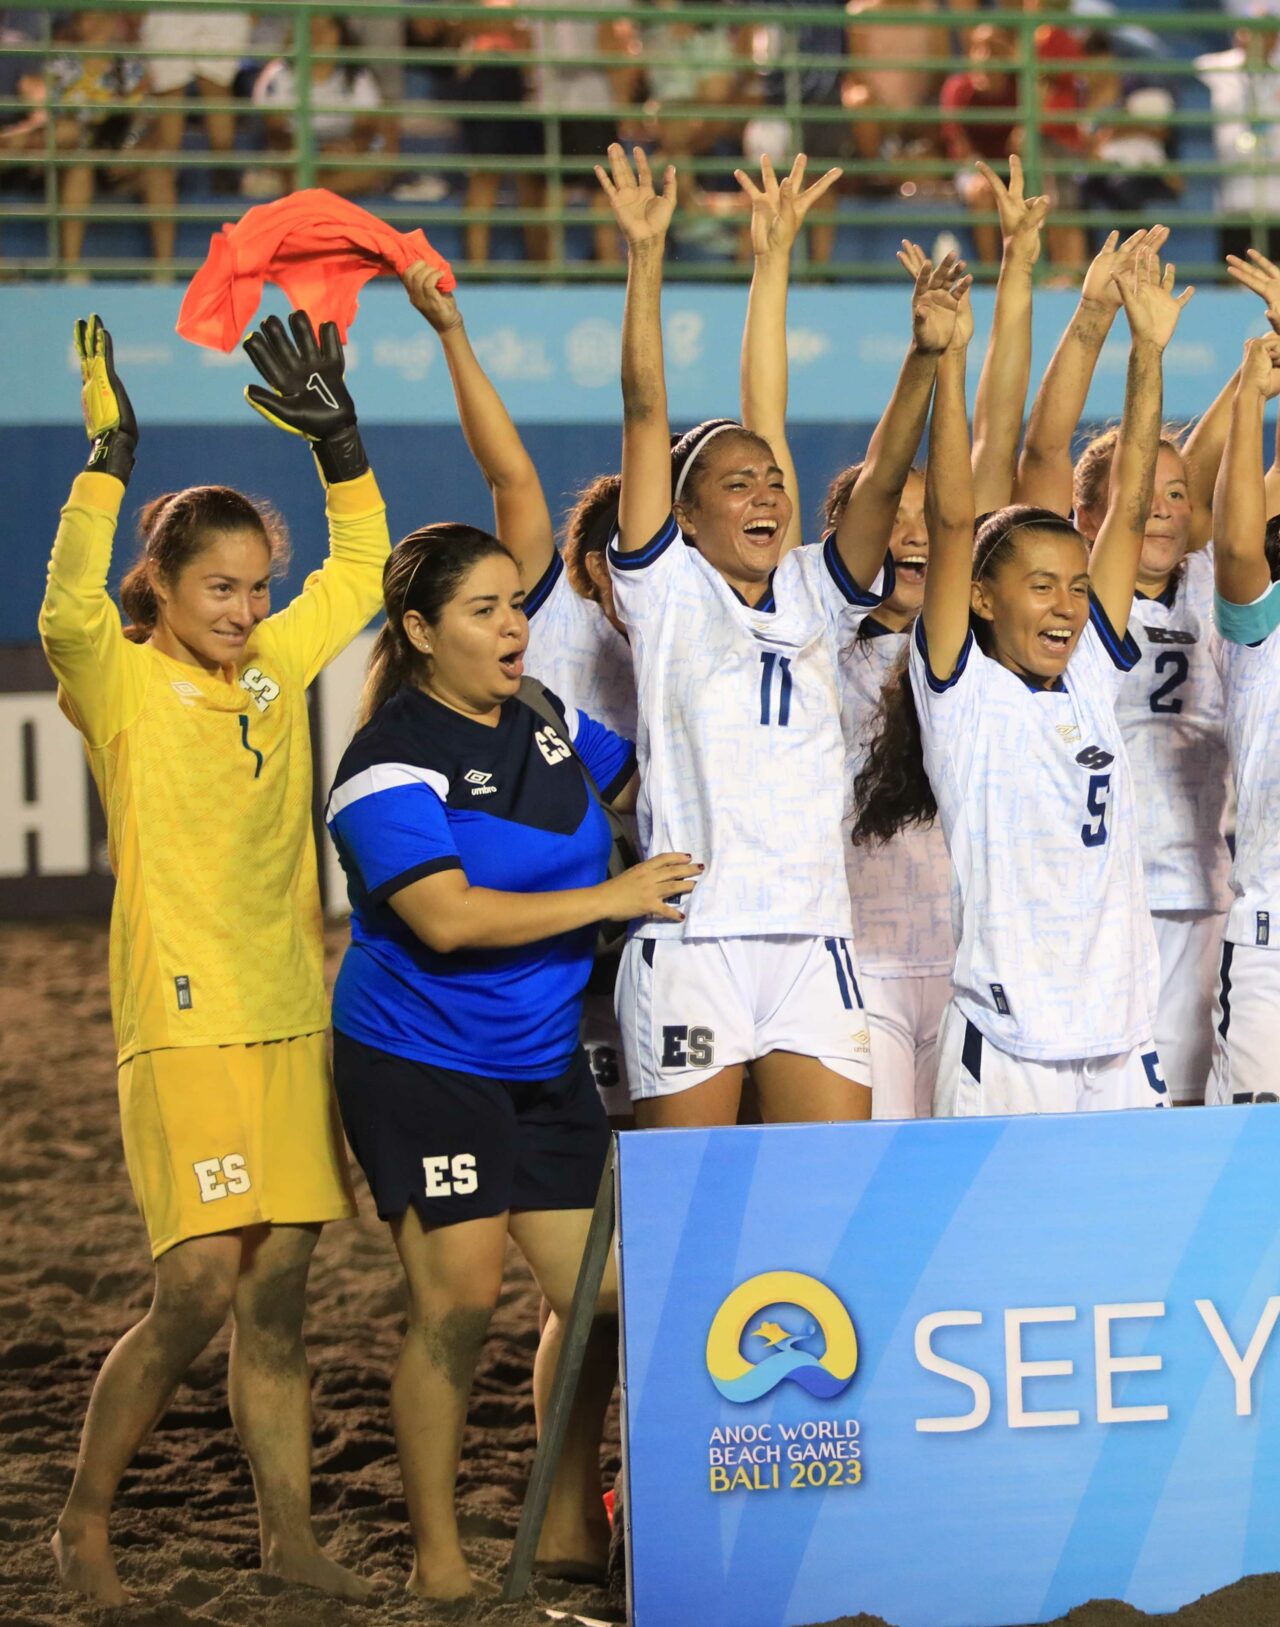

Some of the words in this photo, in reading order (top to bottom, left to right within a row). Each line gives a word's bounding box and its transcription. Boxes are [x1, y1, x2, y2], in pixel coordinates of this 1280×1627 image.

[306, 372, 339, 409] 1
[760, 651, 793, 727] 11
[1150, 651, 1189, 714] 2
[238, 714, 263, 779] 1
[534, 725, 572, 766] ES
[471, 785, 498, 796] umbro
[1081, 774, 1111, 848] 5
[824, 938, 864, 1010] 11
[661, 1024, 715, 1068] ES
[192, 1153, 252, 1204] ES
[422, 1153, 479, 1197] ES
[914, 1300, 1170, 1434] SEE
[709, 1424, 772, 1445] ANOC
[778, 1419, 860, 1441] WORLD
[709, 1444, 781, 1466] BEACH
[787, 1440, 861, 1462] GAMES
[709, 1463, 780, 1492] BALI
[790, 1459, 863, 1489] 2023
